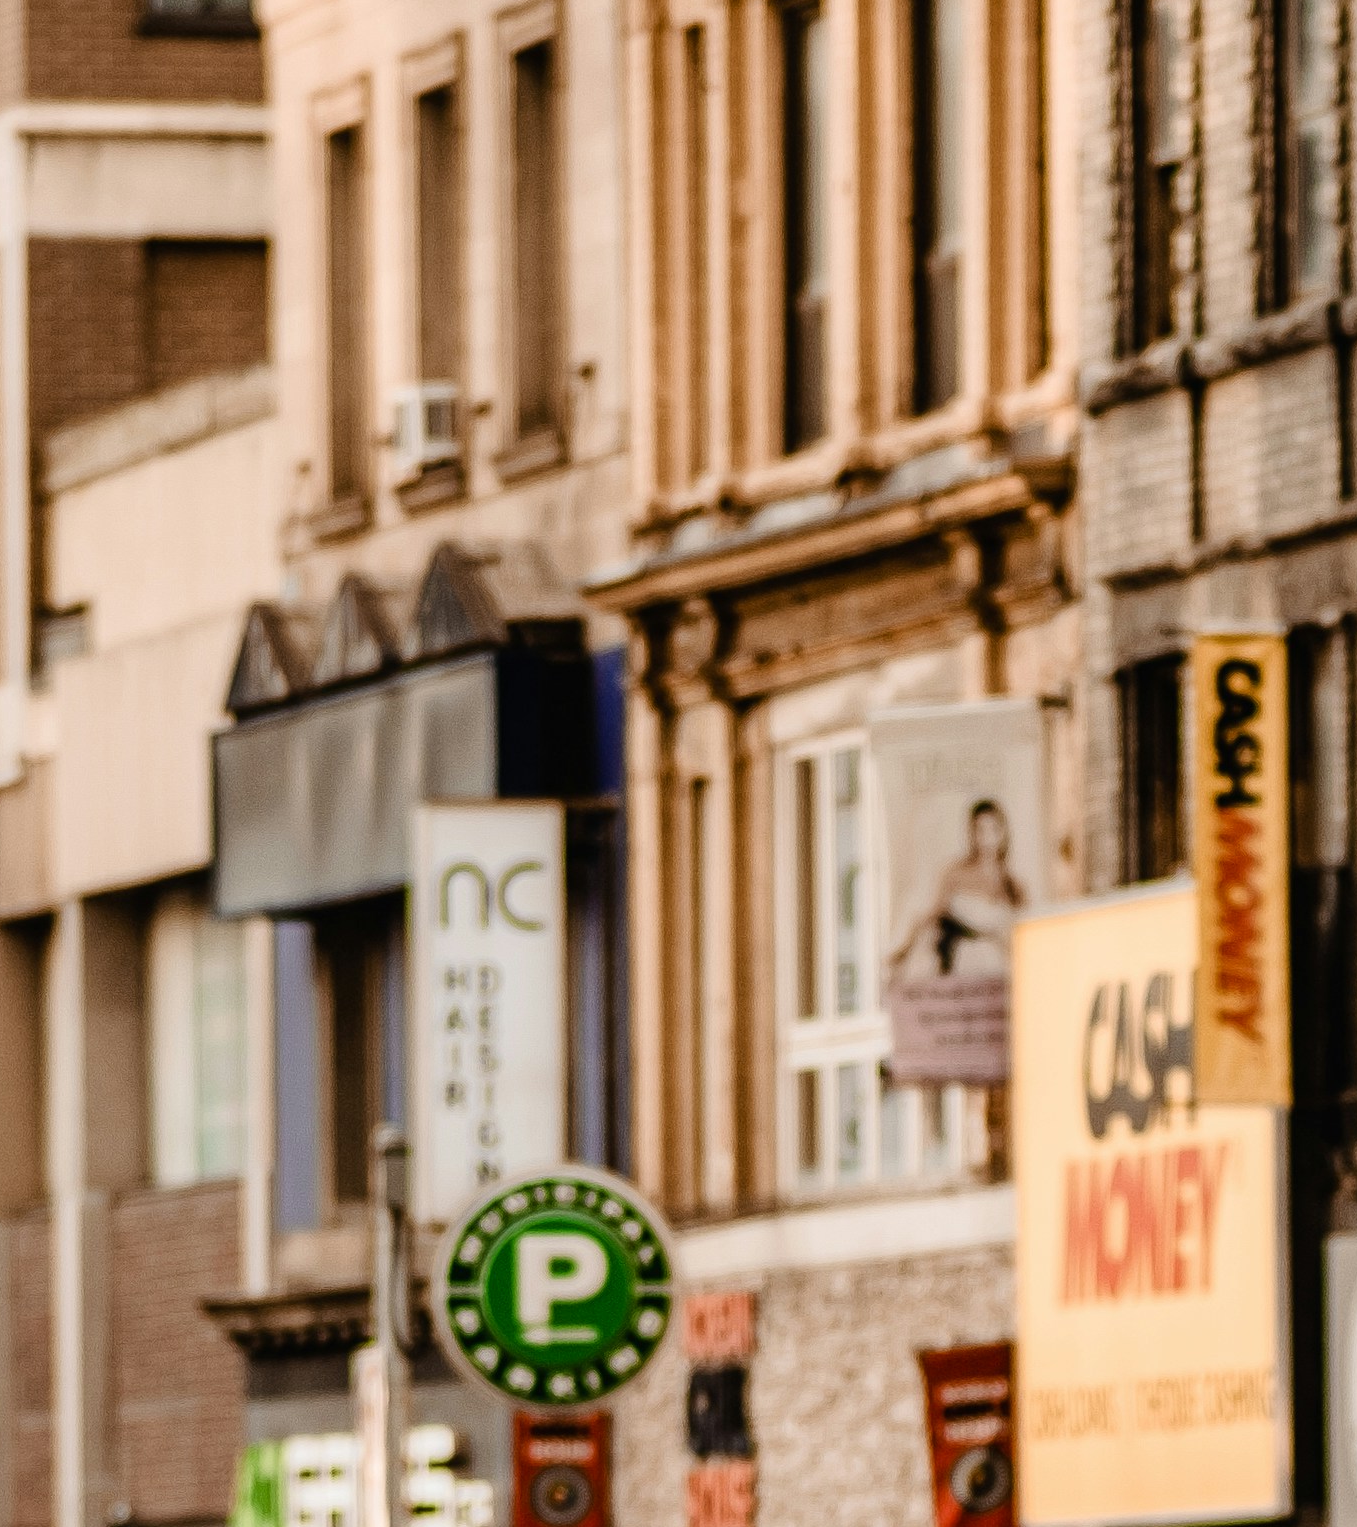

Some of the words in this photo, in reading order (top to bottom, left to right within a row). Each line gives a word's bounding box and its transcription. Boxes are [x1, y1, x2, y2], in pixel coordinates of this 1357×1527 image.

[1214, 658, 1264, 808] CASH
[1216, 807, 1265, 1045] MONEY
[1082, 970, 1196, 1140] CASH
[515, 1231, 609, 1325] P
[1061, 1142, 1230, 1309] MONEY
